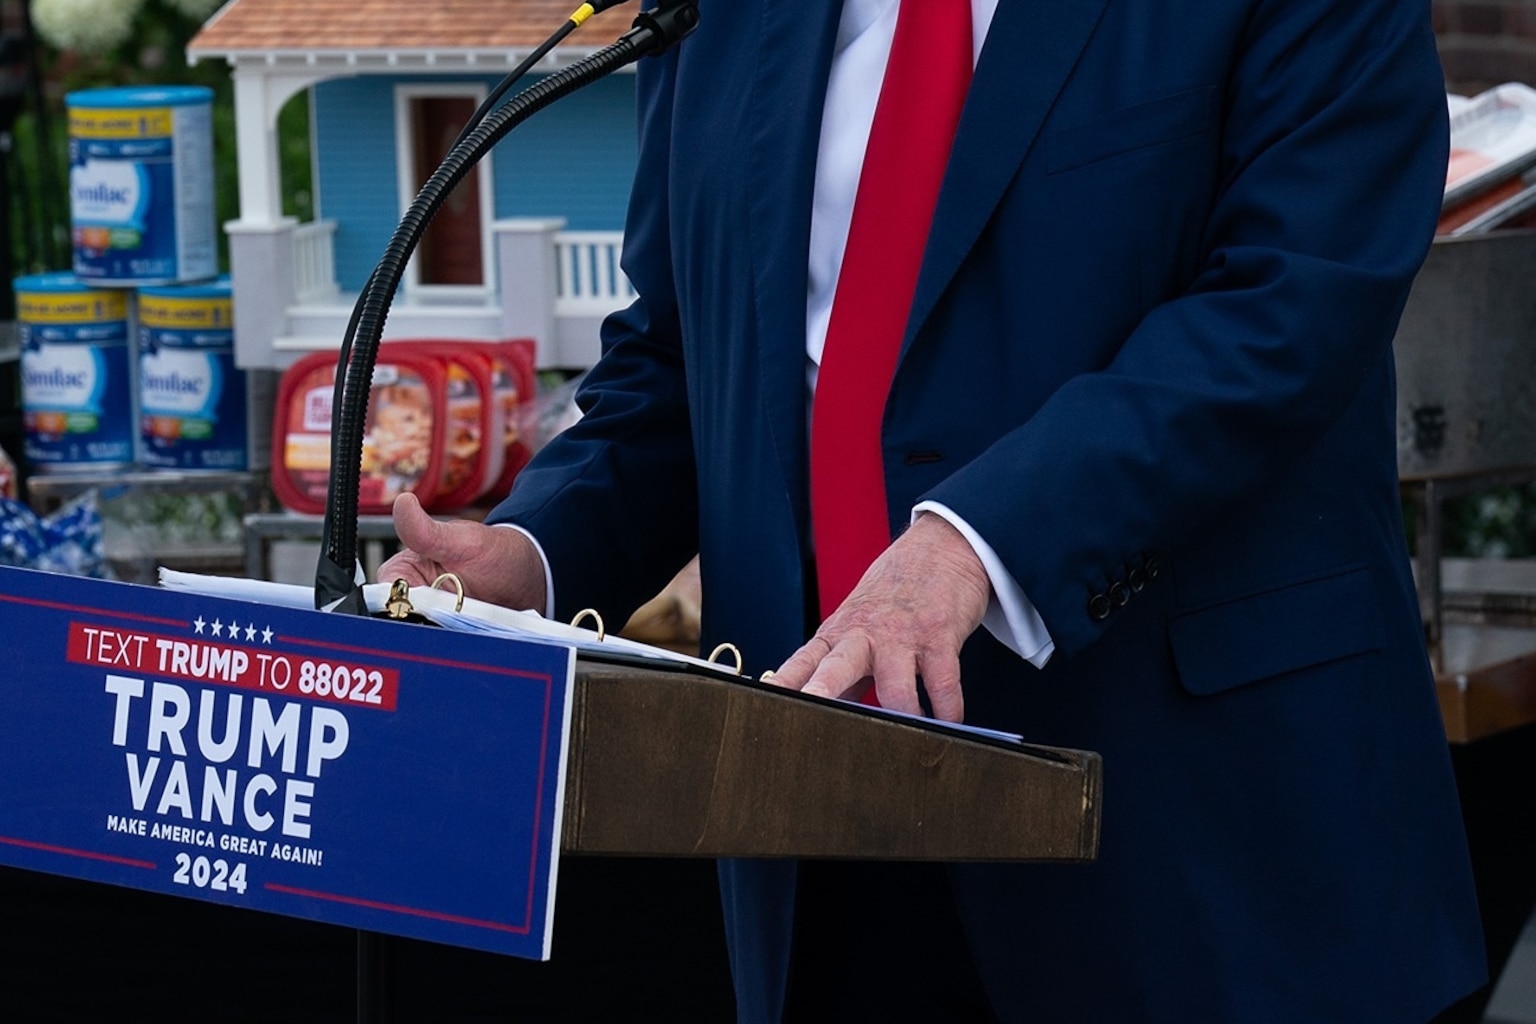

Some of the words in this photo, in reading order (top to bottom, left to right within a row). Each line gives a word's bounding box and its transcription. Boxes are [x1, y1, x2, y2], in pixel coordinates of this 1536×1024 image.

[84, 628, 148, 666] TEXT
[156, 639, 249, 682] TRUMP
[257, 654, 291, 689] TO
[298, 661, 383, 704] 88022
[105, 674, 350, 777] TRUMP
[125, 752, 315, 839] VANCE
[107, 815, 146, 836] MAKE
[151, 823, 215, 848] AMERICA
[220, 834, 267, 856] GREAT
[271, 843, 322, 866] AGAIN!
[174, 852, 248, 894] 2024
